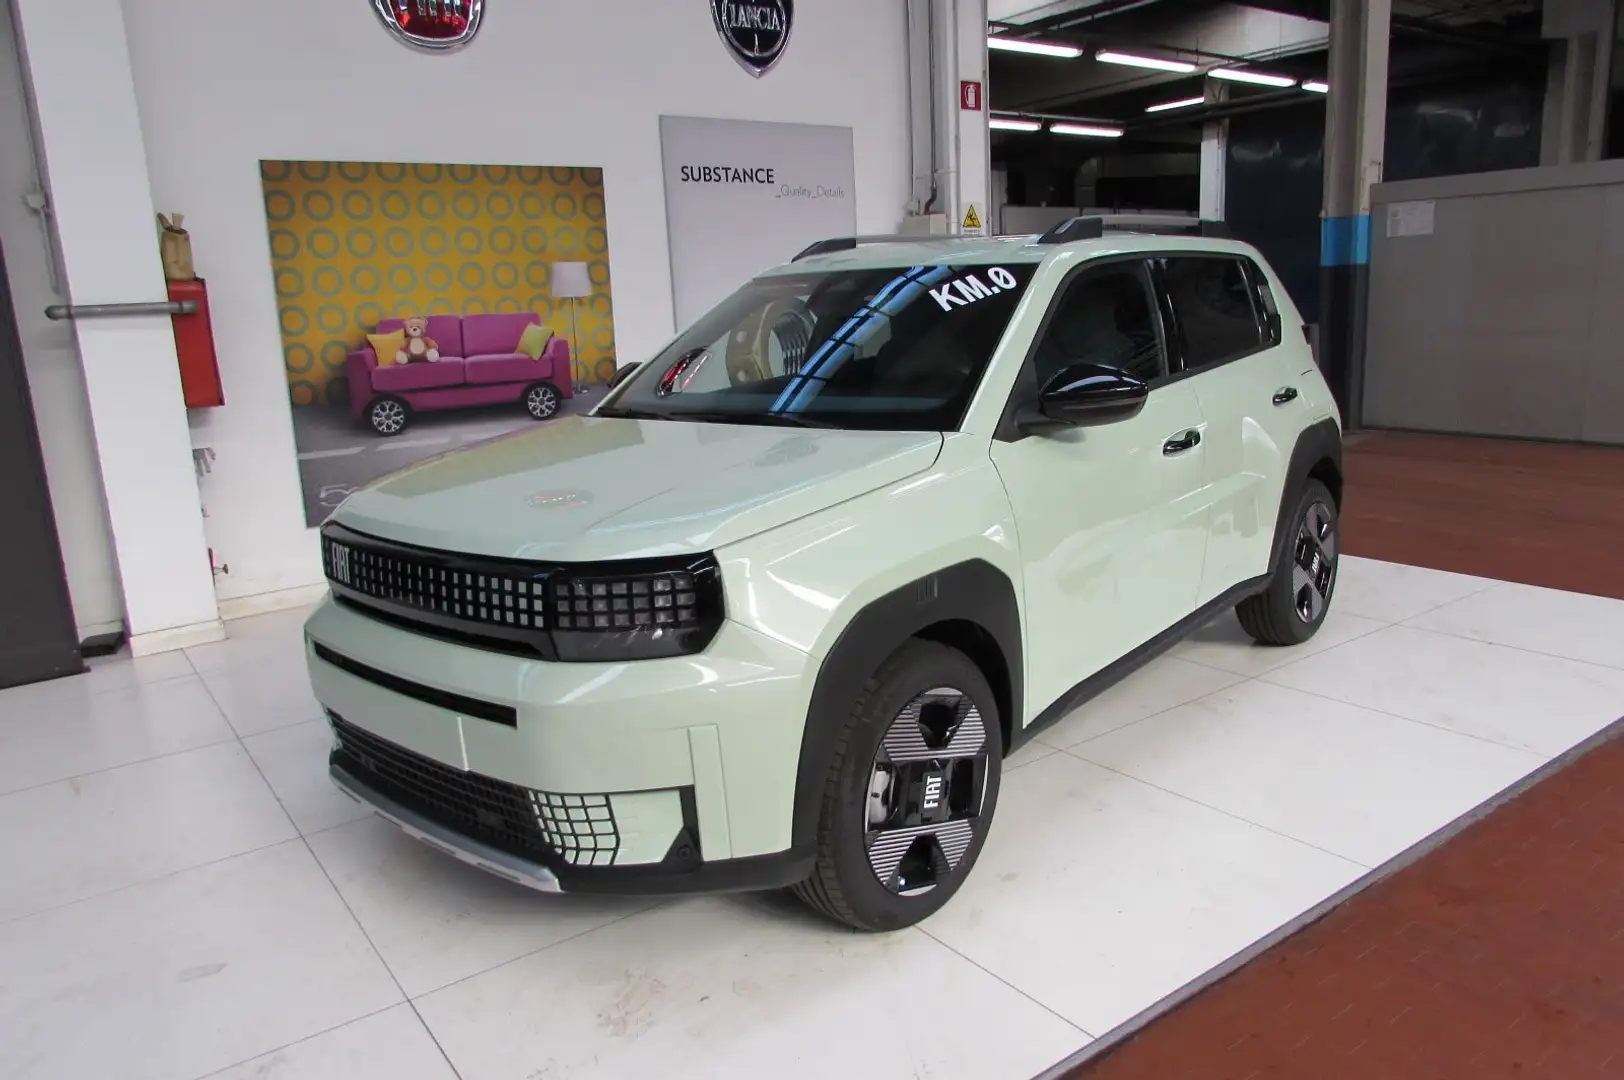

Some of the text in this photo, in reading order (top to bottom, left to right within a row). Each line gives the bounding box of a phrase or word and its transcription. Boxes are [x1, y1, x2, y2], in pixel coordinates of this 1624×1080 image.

[728, 3, 781, 31] LANCIA
[680, 165, 775, 184] SUBSTANCE
[331, 541, 351, 584] FIAT
[923, 775, 943, 809] FIAT
